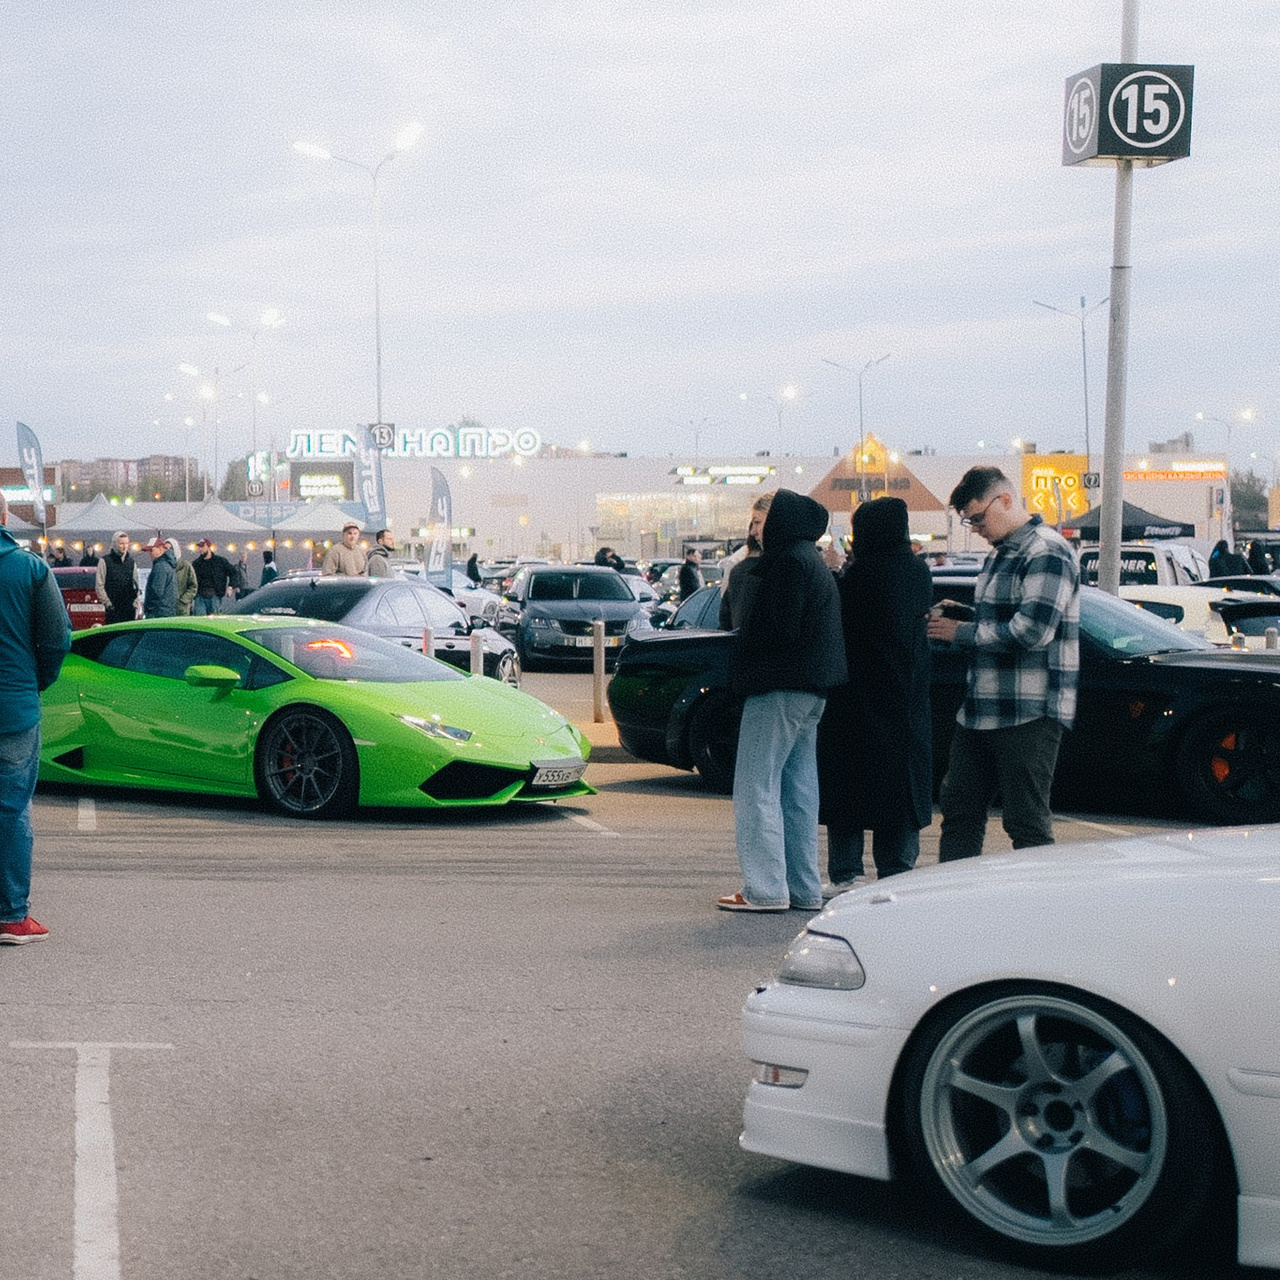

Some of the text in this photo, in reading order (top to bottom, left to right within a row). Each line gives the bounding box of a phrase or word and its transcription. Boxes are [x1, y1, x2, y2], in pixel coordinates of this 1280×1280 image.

[1071, 88, 1091, 141] 15
[1121, 83, 1170, 135] 15
[374, 429, 389, 446] 13
[457, 426, 542, 458] ПРО
